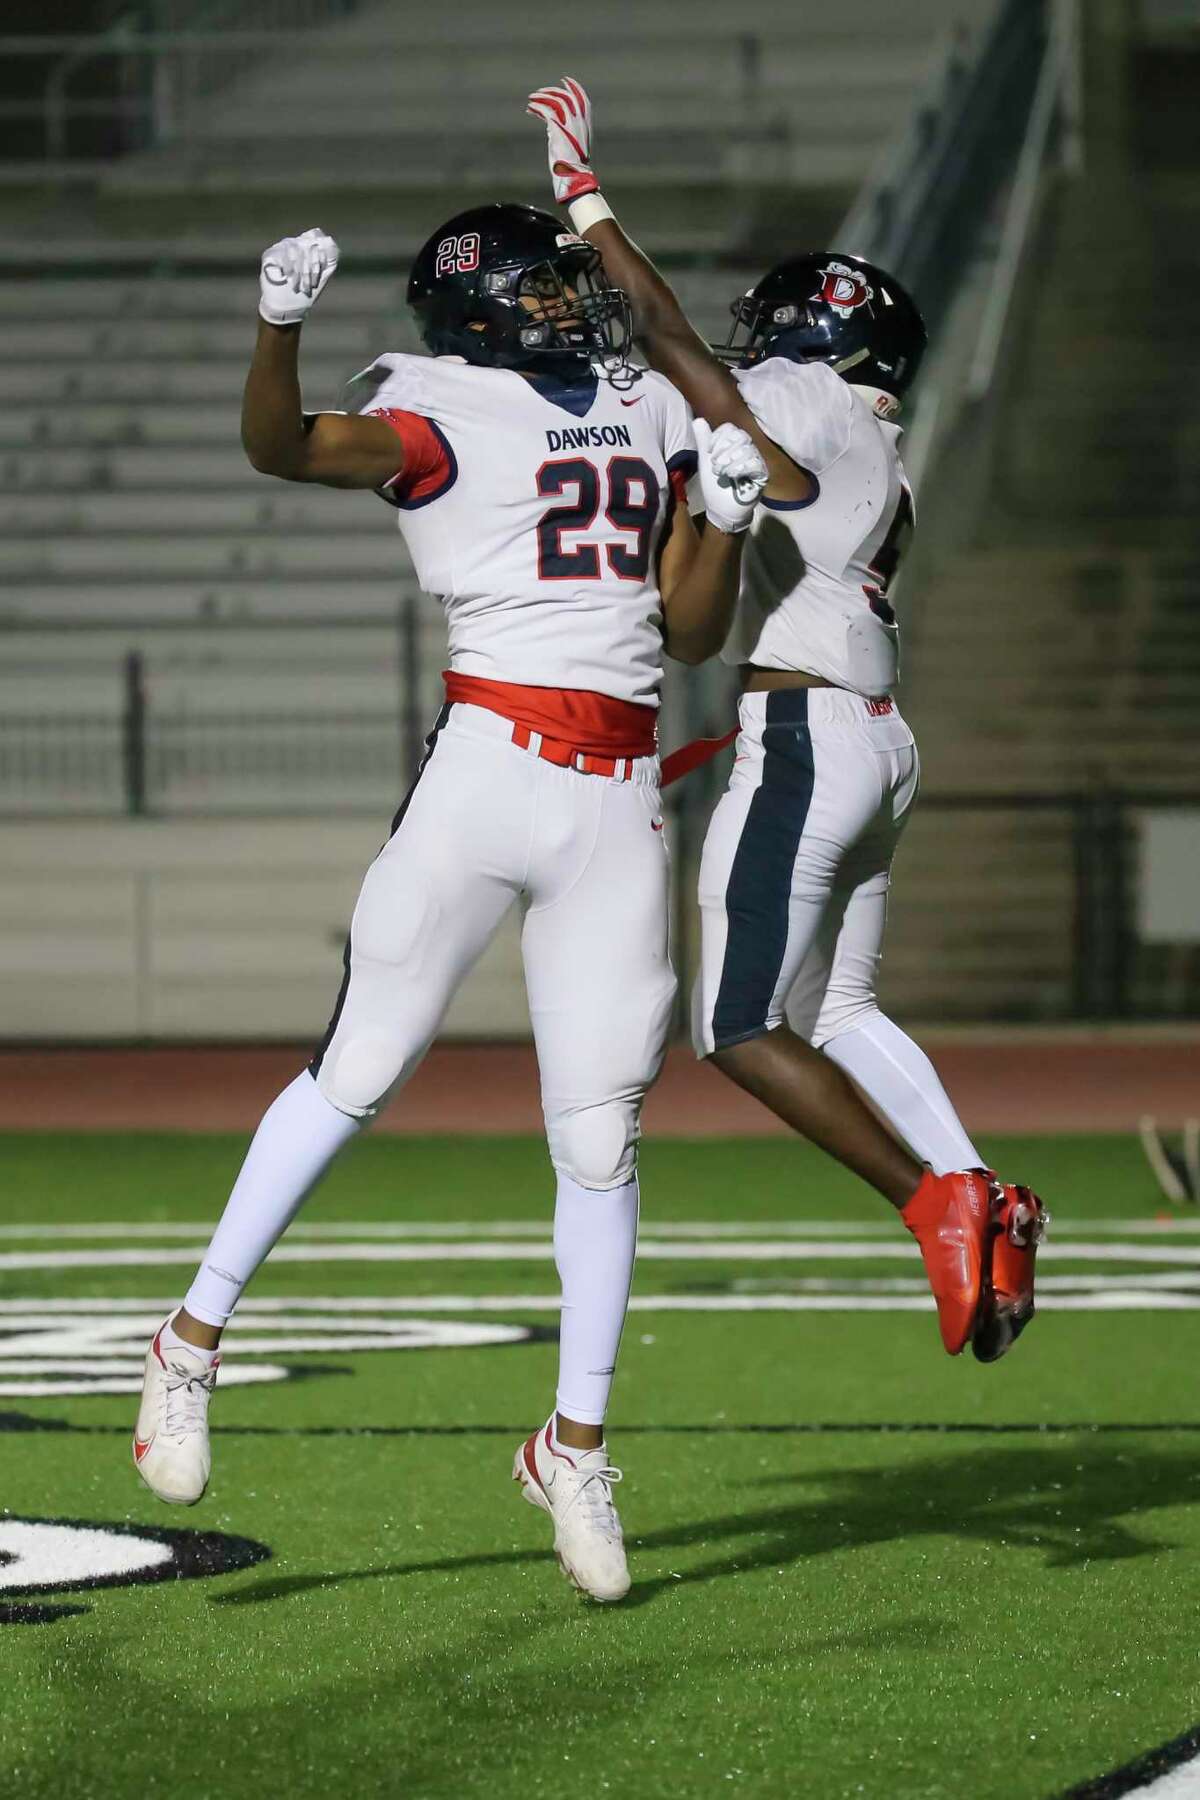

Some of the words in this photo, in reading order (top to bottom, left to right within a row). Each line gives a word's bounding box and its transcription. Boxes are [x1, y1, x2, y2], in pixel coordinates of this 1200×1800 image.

[435, 232, 482, 279] 29
[545, 424, 632, 452] DAWSON
[535, 455, 660, 583] 29
